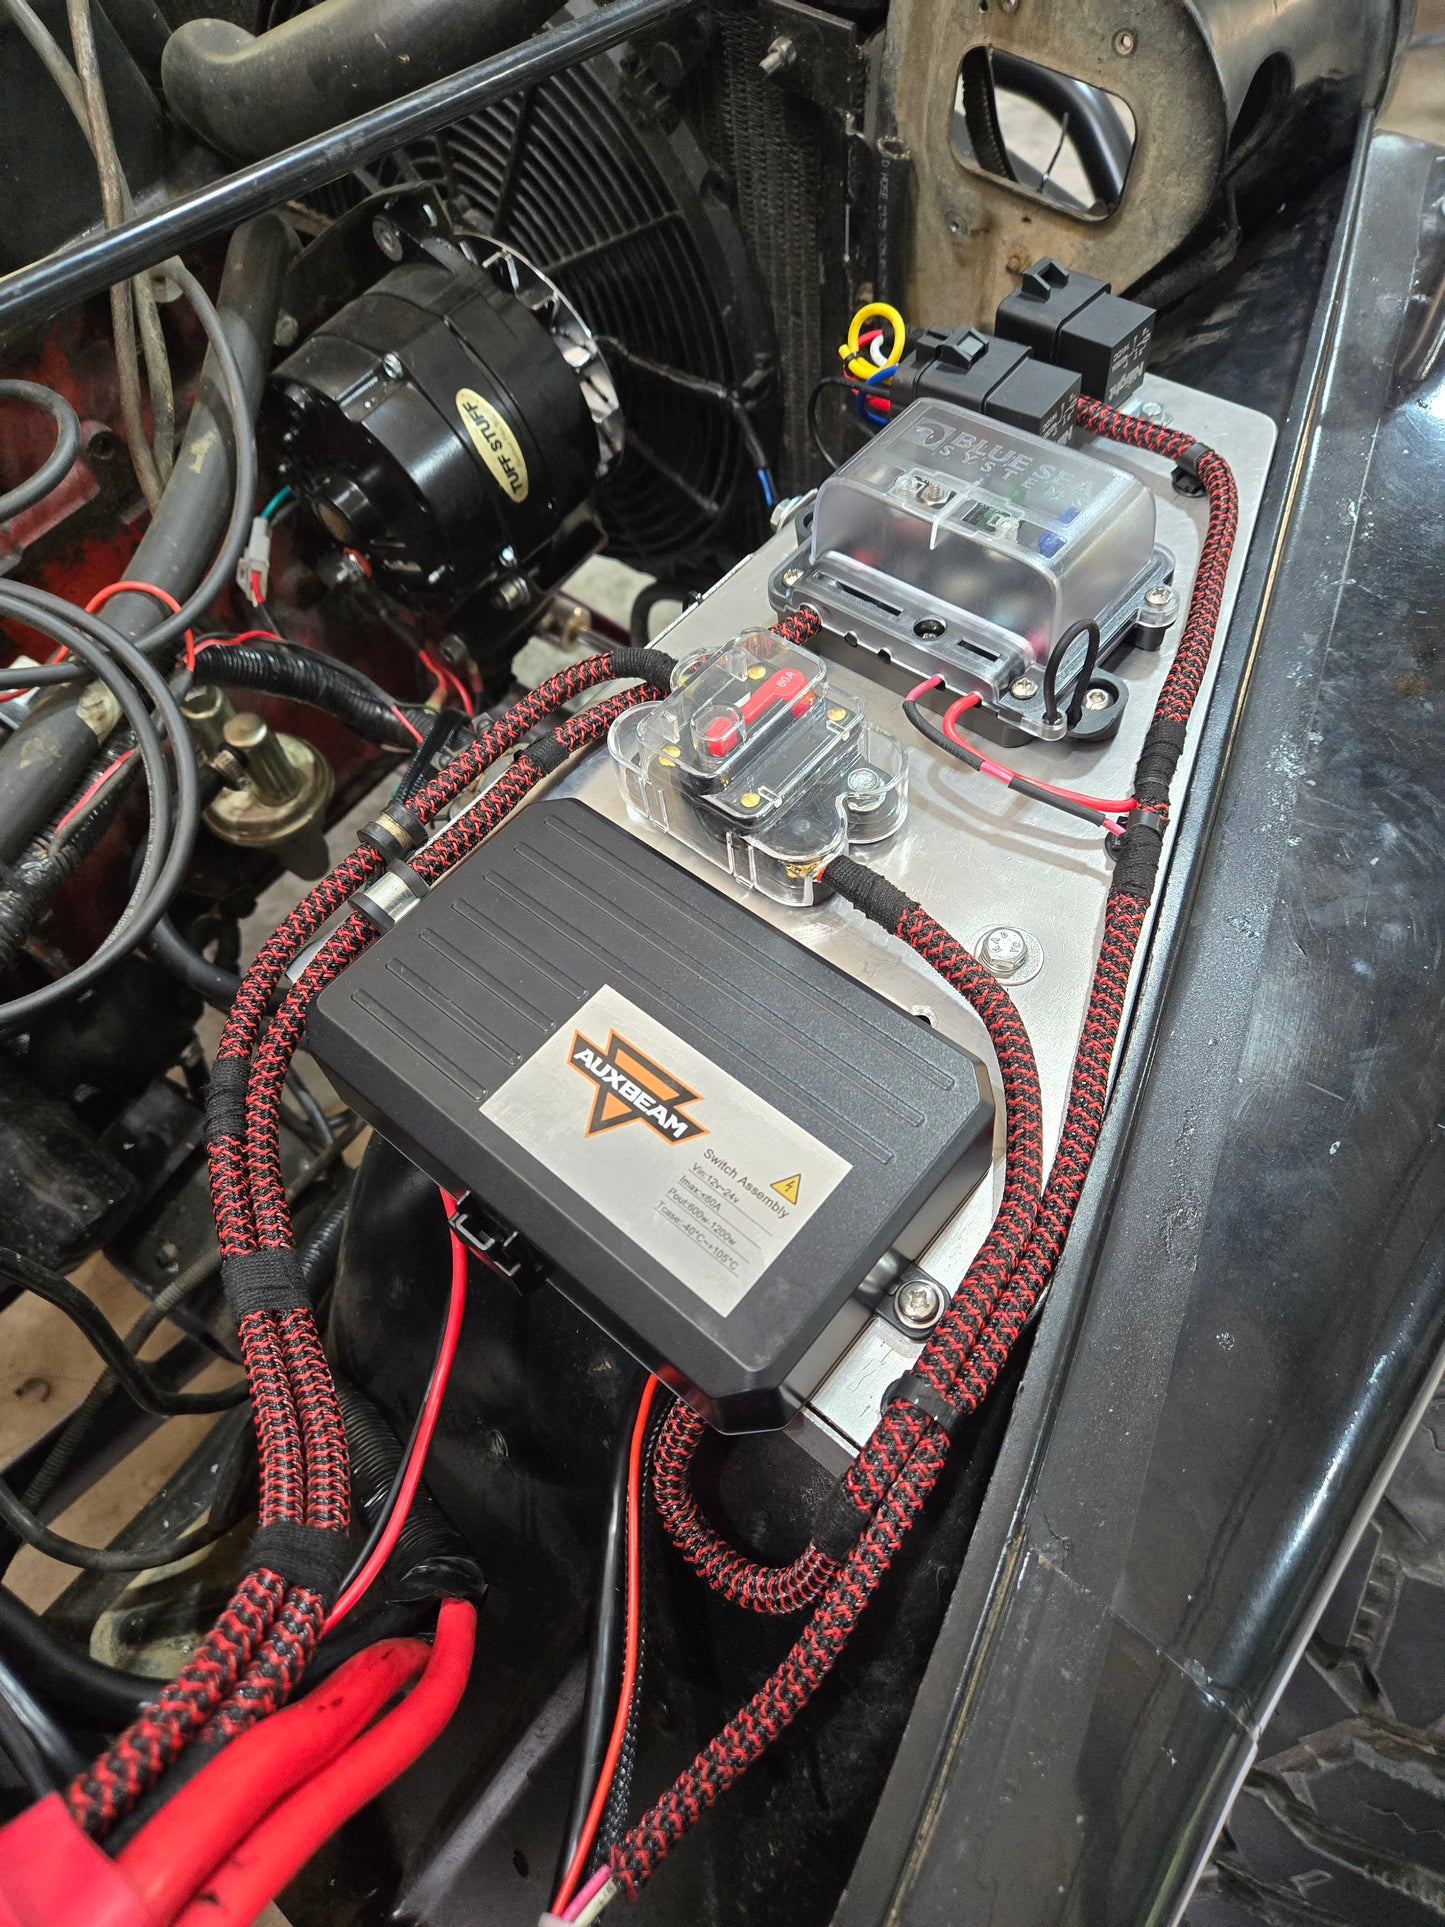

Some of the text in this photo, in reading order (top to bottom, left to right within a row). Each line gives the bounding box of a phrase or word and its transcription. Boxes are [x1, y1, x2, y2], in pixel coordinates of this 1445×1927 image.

[462, 401, 502, 452] STUFF
[955, 431, 1034, 472] BLUE
[497, 455, 522, 494] TUFF
[776, 671, 797, 687] 60A
[131, 844, 154, 907] Performance
[573, 1048, 689, 1138] AUXBEAM
[703, 1148, 789, 1219] Switch Assembly
